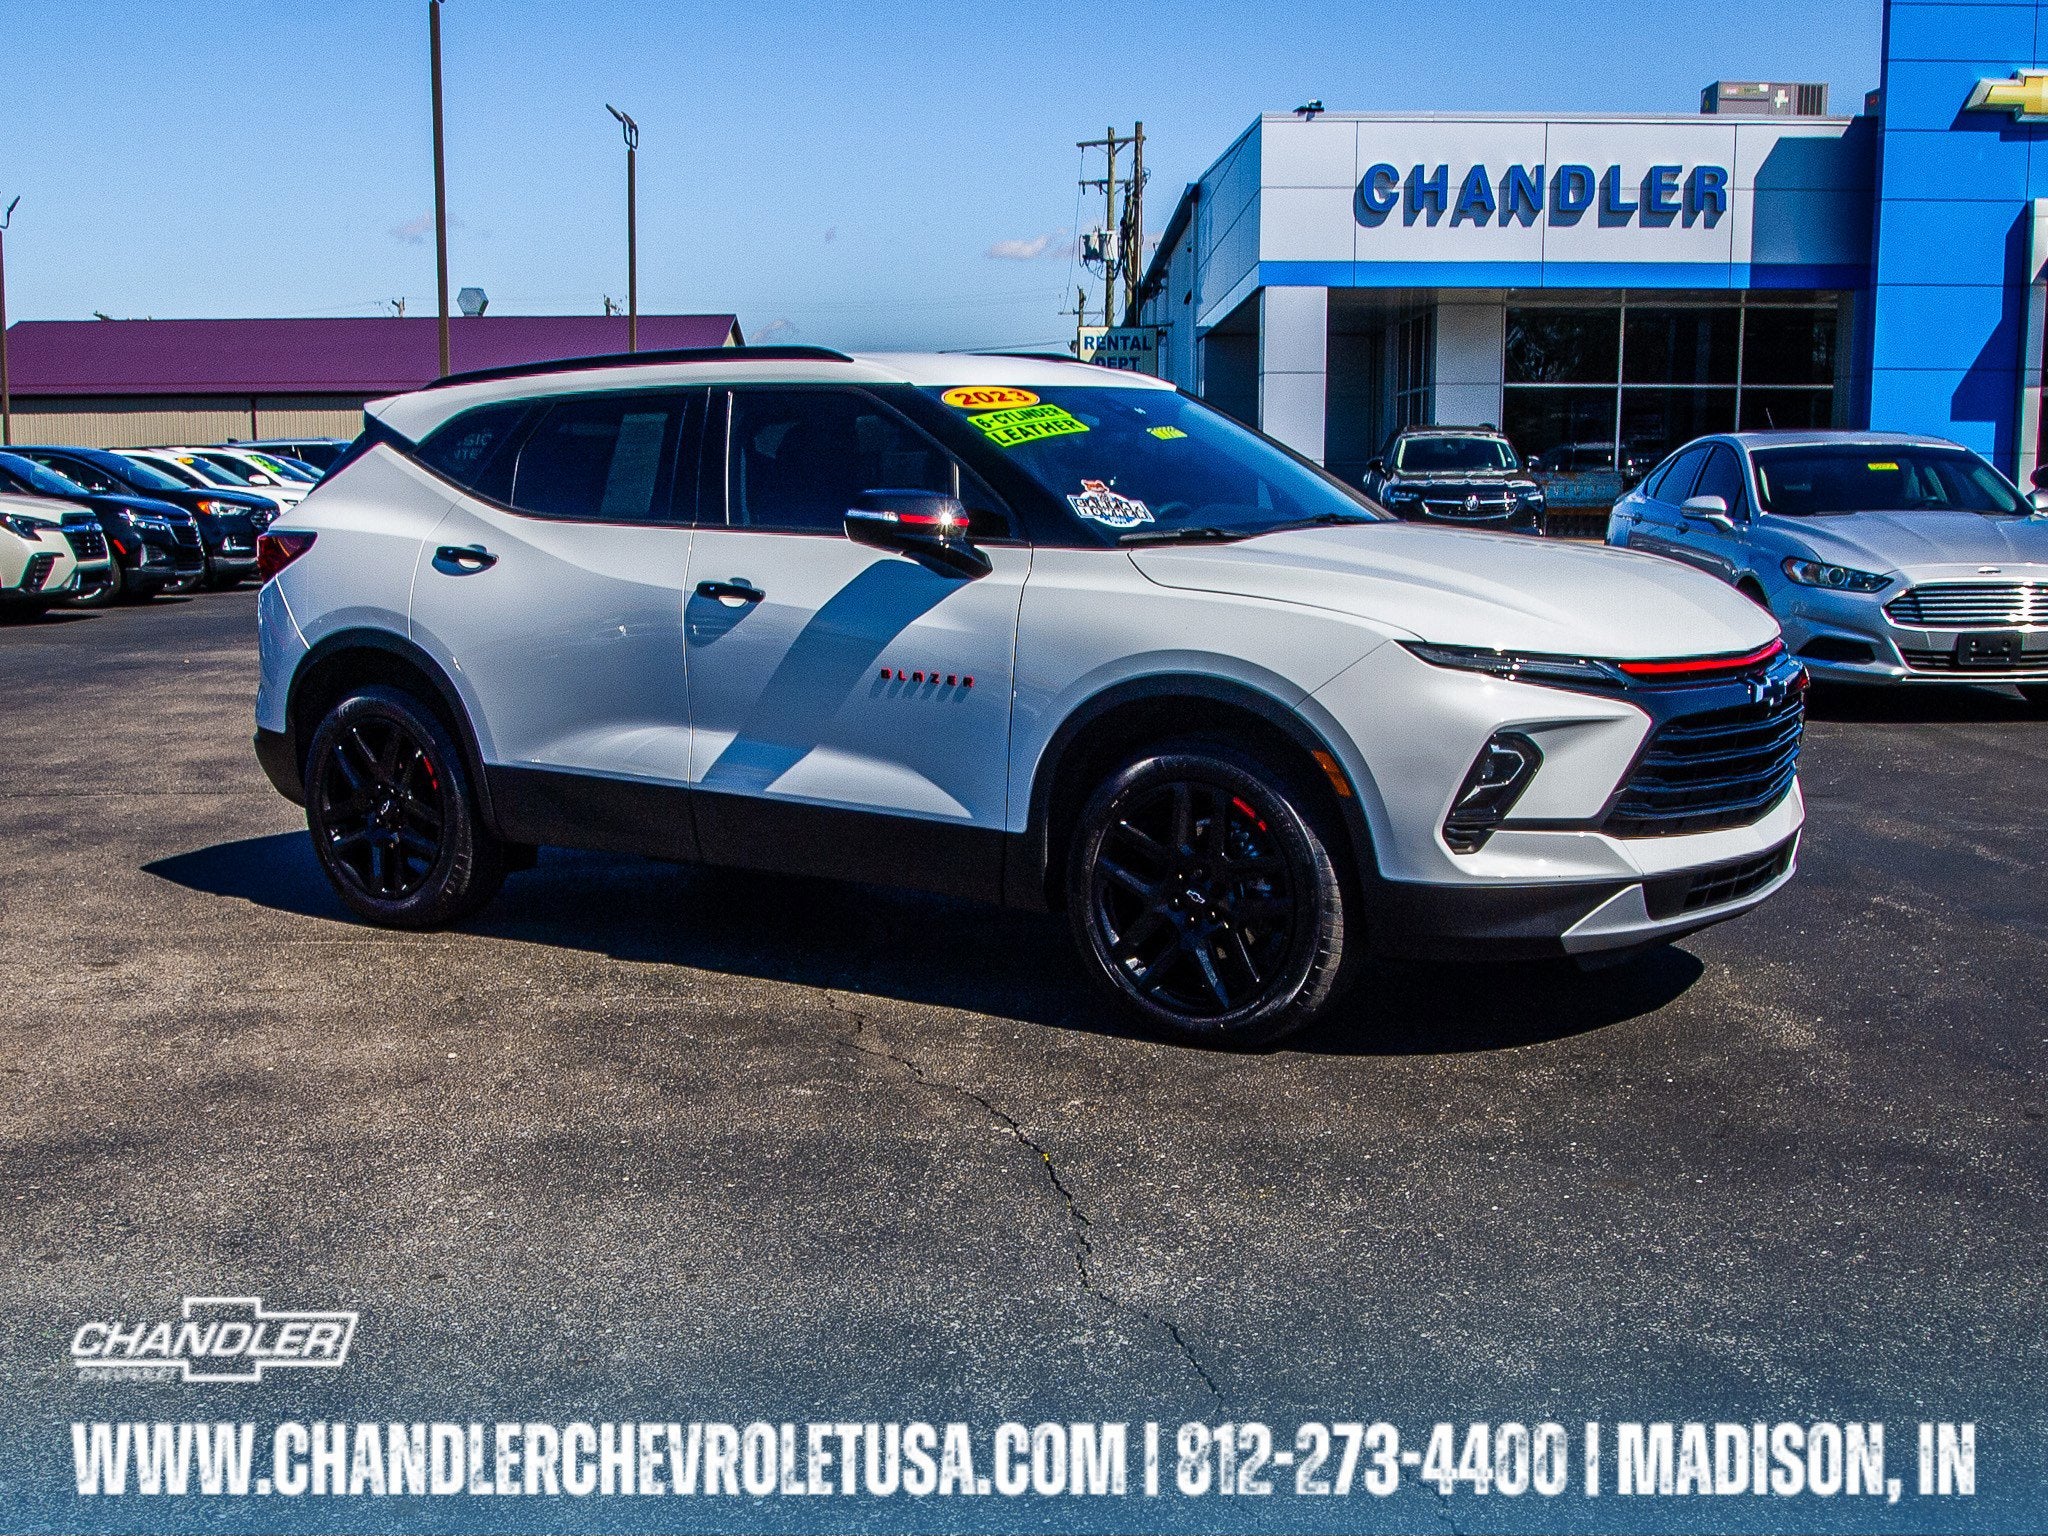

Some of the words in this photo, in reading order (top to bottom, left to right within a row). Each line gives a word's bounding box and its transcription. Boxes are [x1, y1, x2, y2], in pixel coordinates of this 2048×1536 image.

[1362, 163, 1728, 213] CHANDLER
[1084, 335, 1152, 350] RENTAL
[1094, 356, 1140, 371] DEPT
[955, 391, 1030, 406] 2023
[976, 407, 1065, 429] 6-CYLINDER
[992, 419, 1082, 444] LEATHER
[881, 667, 974, 688] BLAZER
